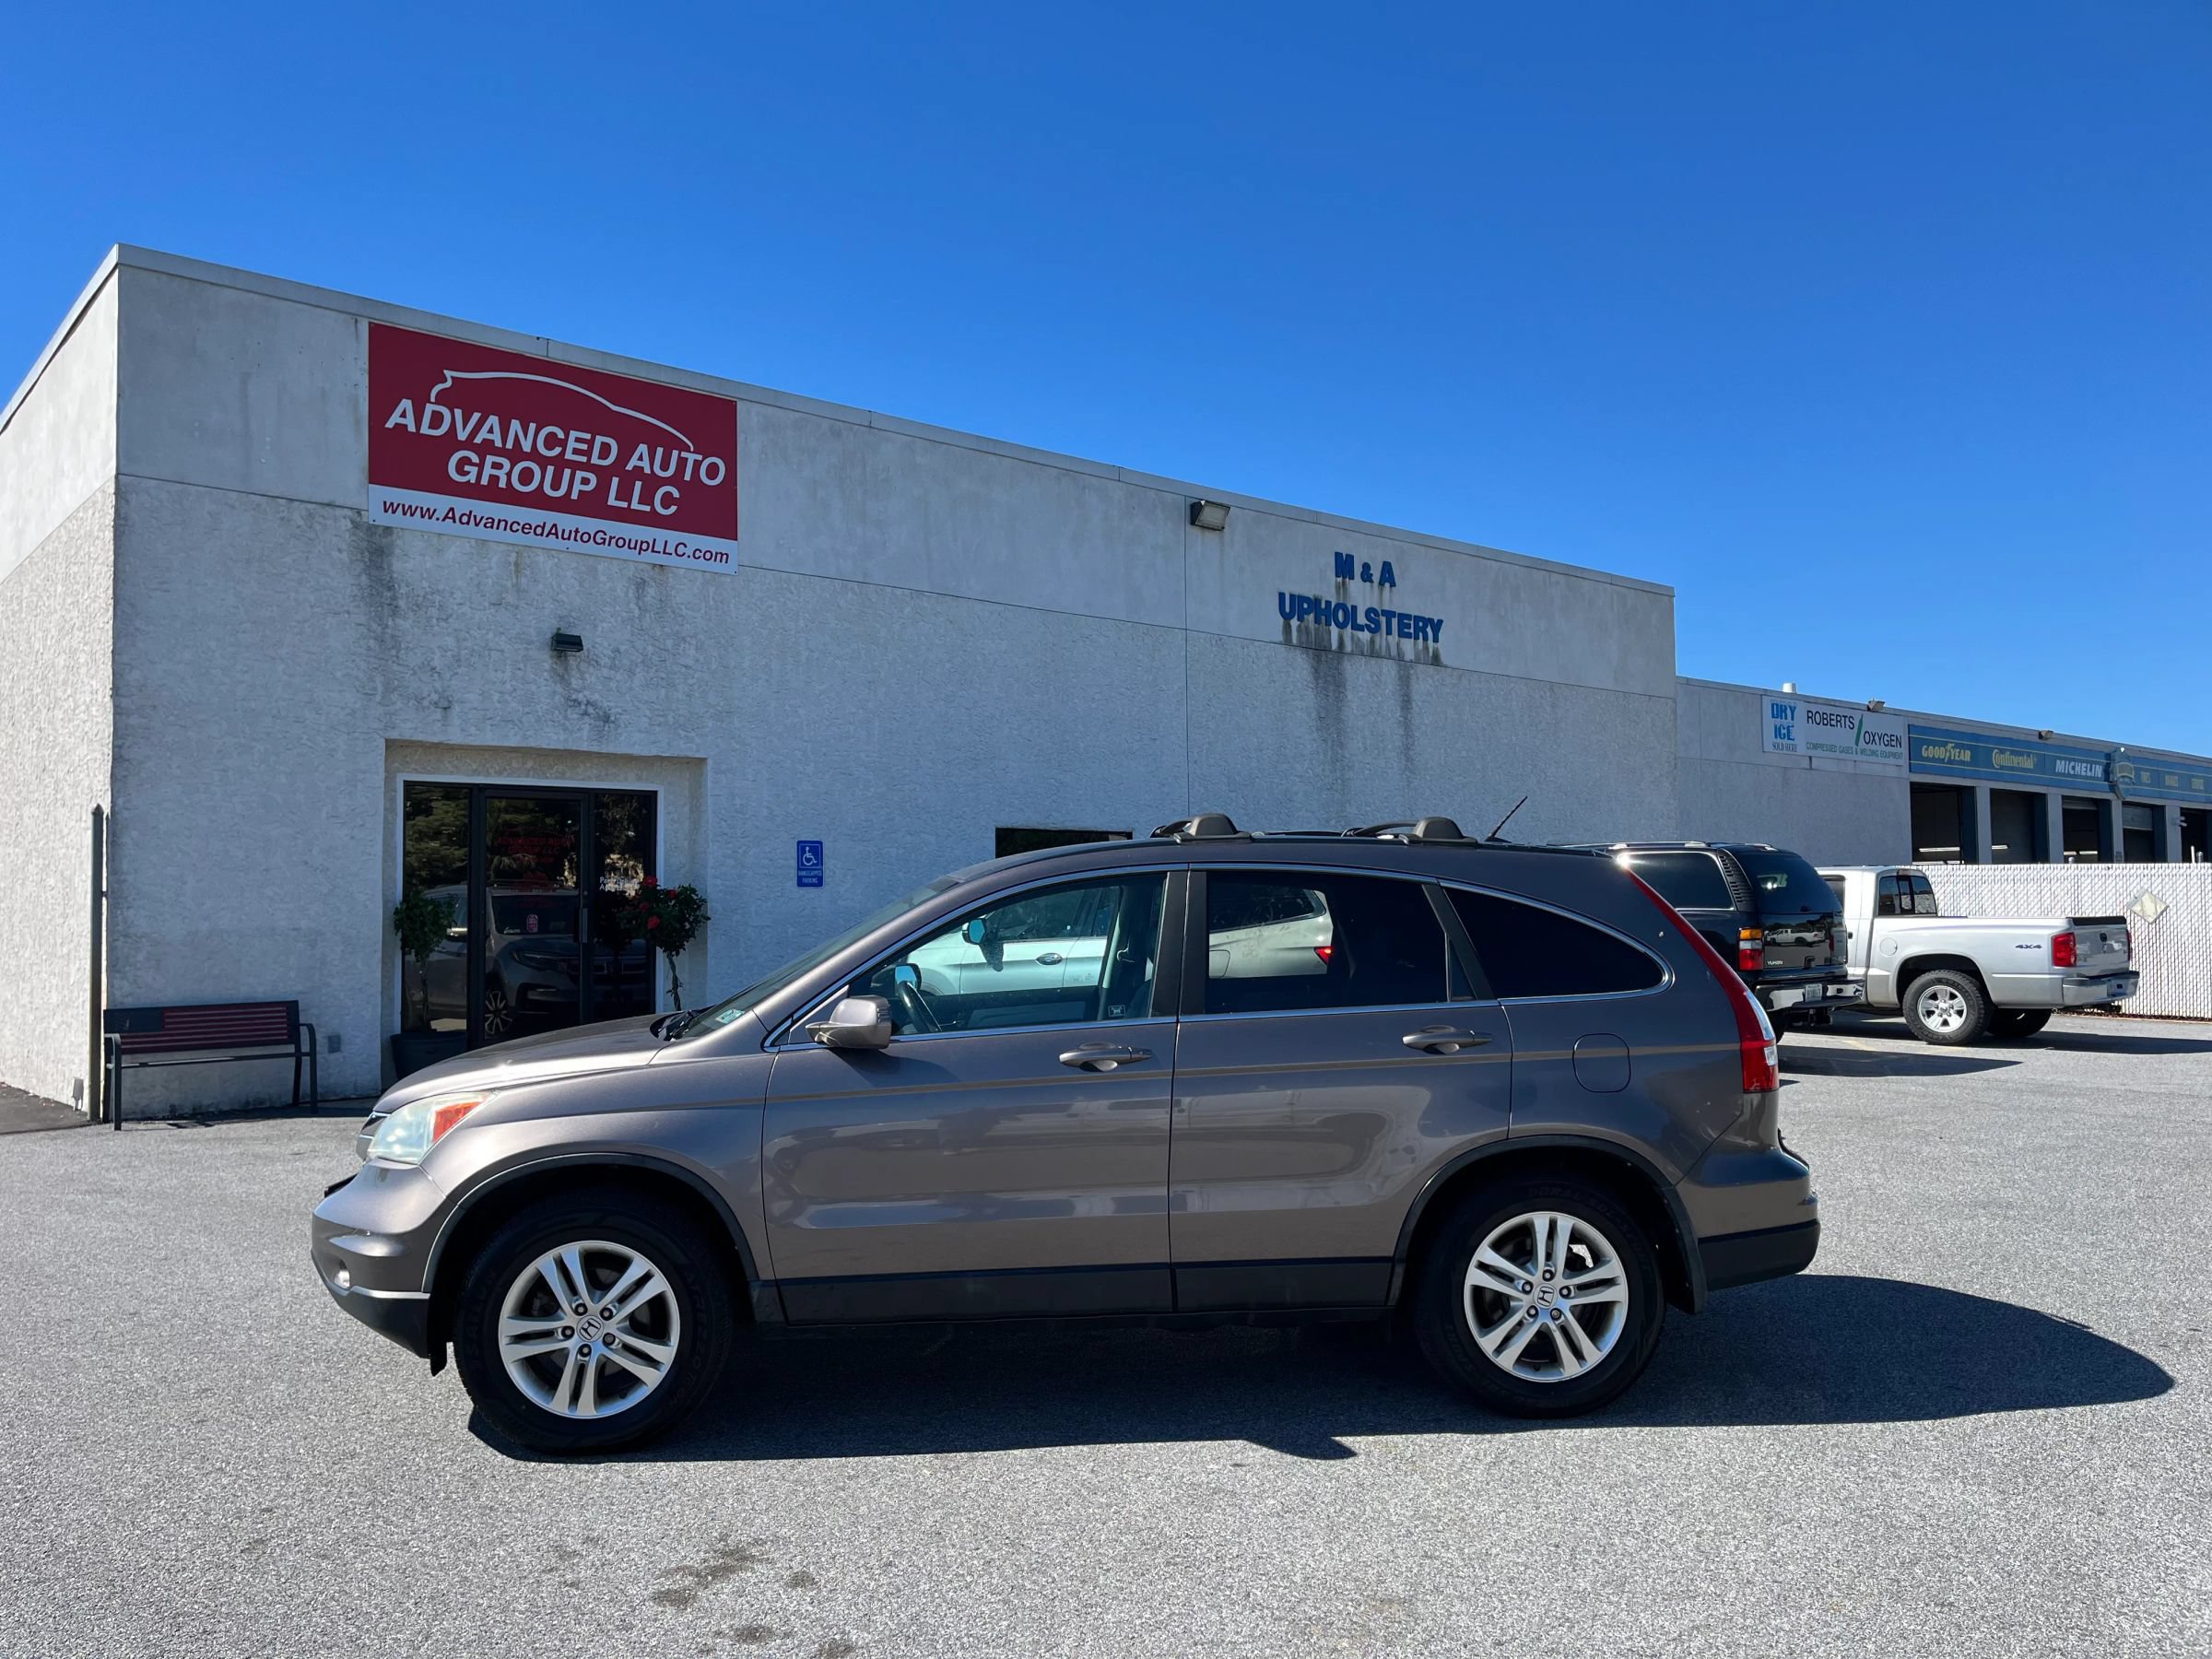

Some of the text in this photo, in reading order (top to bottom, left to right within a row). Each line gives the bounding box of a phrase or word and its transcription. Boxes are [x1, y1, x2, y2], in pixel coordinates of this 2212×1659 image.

[383, 398, 726, 487] ADVANCED AUTO
[447, 450, 681, 516] GROUP LLC
[382, 500, 730, 565] www.AdvancedAutoGroupLLC.com
[1335, 551, 1396, 588] M & A
[1278, 592, 1444, 643] UPHOLSTERY
[1771, 702, 1796, 721] DRY
[1806, 710, 1855, 730] ROBERTS
[1774, 724, 1794, 741] ICE
[1863, 731, 1902, 748] OXYGEN
[1806, 742, 1837, 753] COMPRESSED
[1839, 745, 1853, 755] GASES
[1922, 743, 1971, 763] GOODYEAR
[1993, 748, 2037, 769] Continental
[2055, 759, 2102, 778] MICHELIN
